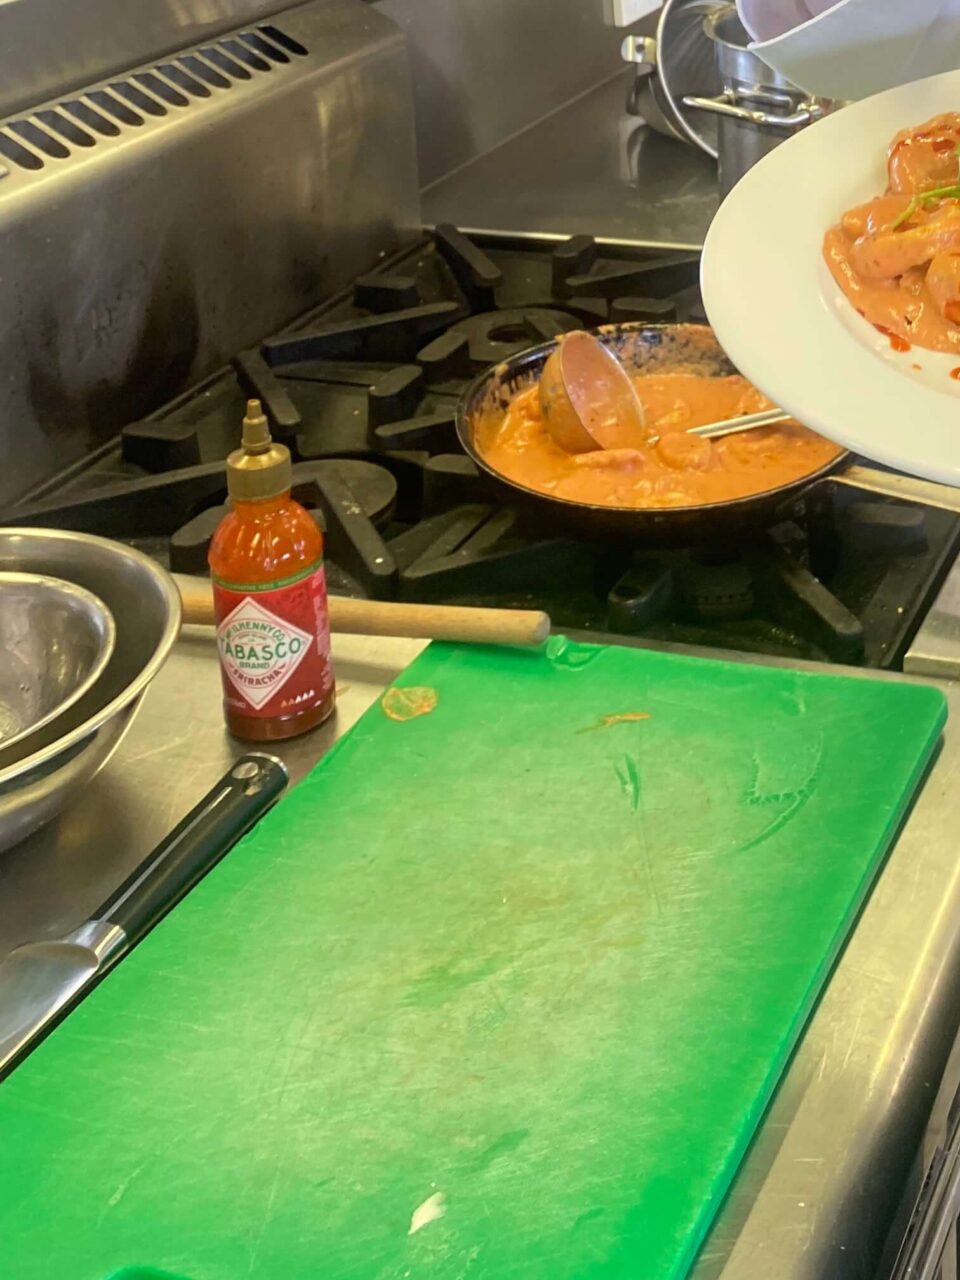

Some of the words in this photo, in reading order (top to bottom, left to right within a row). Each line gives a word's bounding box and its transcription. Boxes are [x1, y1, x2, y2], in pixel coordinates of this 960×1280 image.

[218, 635, 301, 661] TABASCO
[239, 661, 270, 669] BRAND
[232, 669, 281, 686] SRIRACHA
